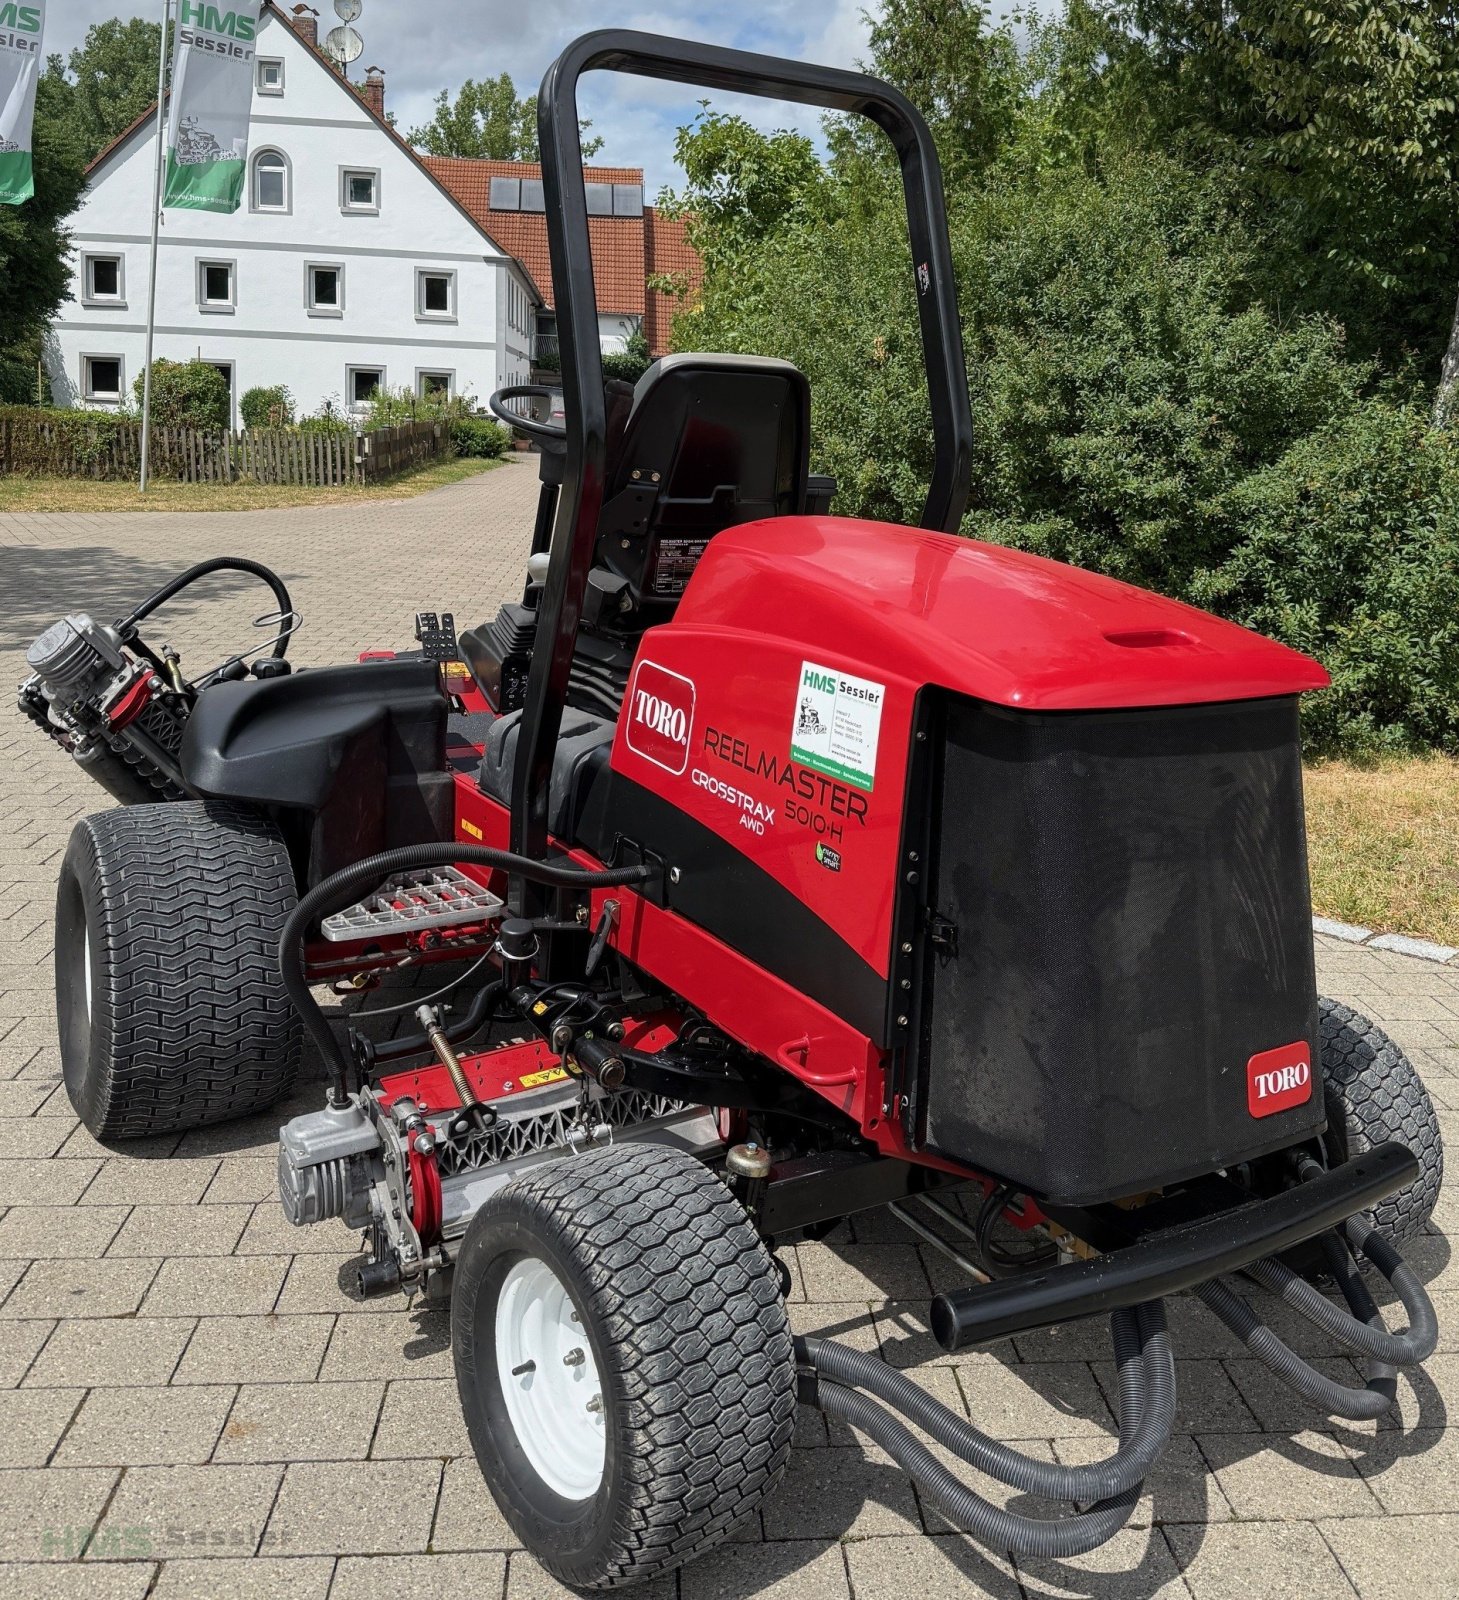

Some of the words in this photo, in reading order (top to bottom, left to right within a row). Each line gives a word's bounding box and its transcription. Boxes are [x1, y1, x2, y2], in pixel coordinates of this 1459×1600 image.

[181, 0, 256, 41] HMS
[179, 30, 254, 60] Sessler
[803, 669, 837, 695] HMS
[839, 681, 880, 704] Sessler
[703, 726, 869, 827] REELMASTER
[691, 768, 776, 825] CROSSTRAX
[739, 813, 765, 836] AWD
[1254, 1062, 1309, 1099] TORO
